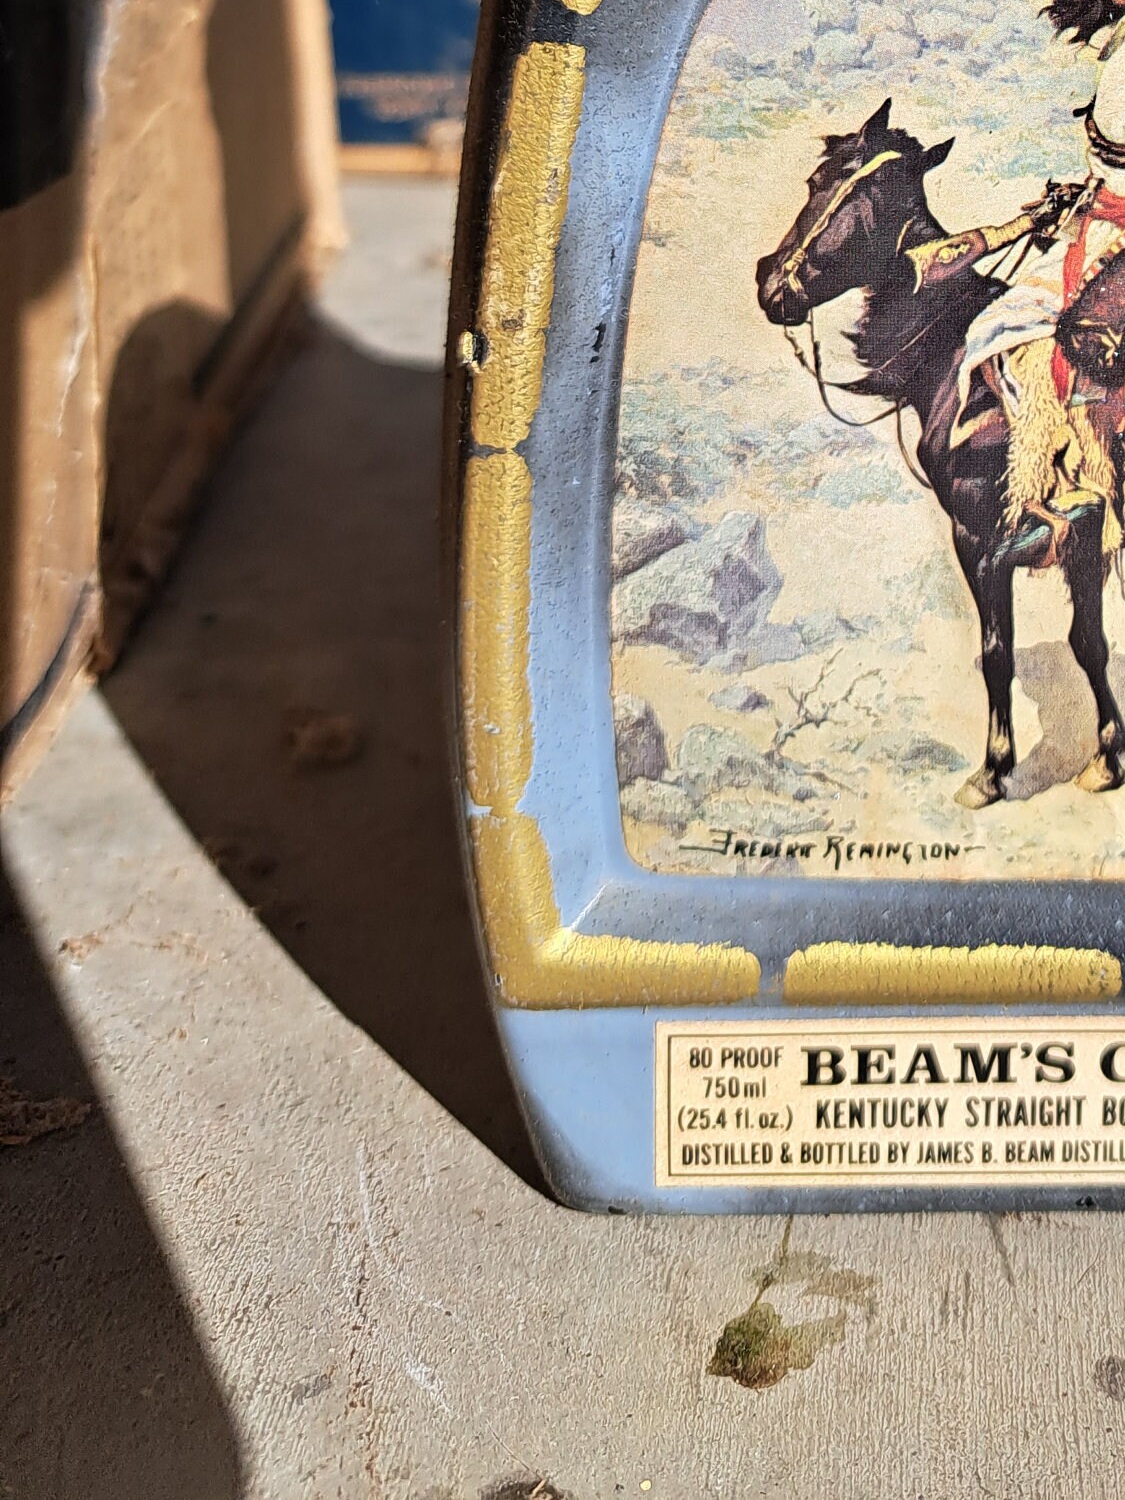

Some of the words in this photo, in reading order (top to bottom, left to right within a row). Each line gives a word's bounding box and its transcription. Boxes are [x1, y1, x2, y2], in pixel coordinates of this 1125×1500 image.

[689, 1046, 713, 1069] 80
[721, 1046, 784, 1068] PROOF
[800, 1041, 1076, 1086] BEAM'S
[702, 1075, 767, 1099] 750ml
[677, 1104, 727, 1131] (25.4
[815, 1097, 950, 1130] KENTUCKY
[965, 1095, 1087, 1128] STRAIGHT
[681, 1141, 774, 1166] DISTILLED
[779, 1142, 794, 1165] &
[799, 1141, 880, 1165] BOTTLED
[887, 1140, 911, 1164] BY
[917, 1140, 975, 1165] JAMES
[981, 1140, 999, 1164] B.
[1005, 1140, 1056, 1164] BEAM
